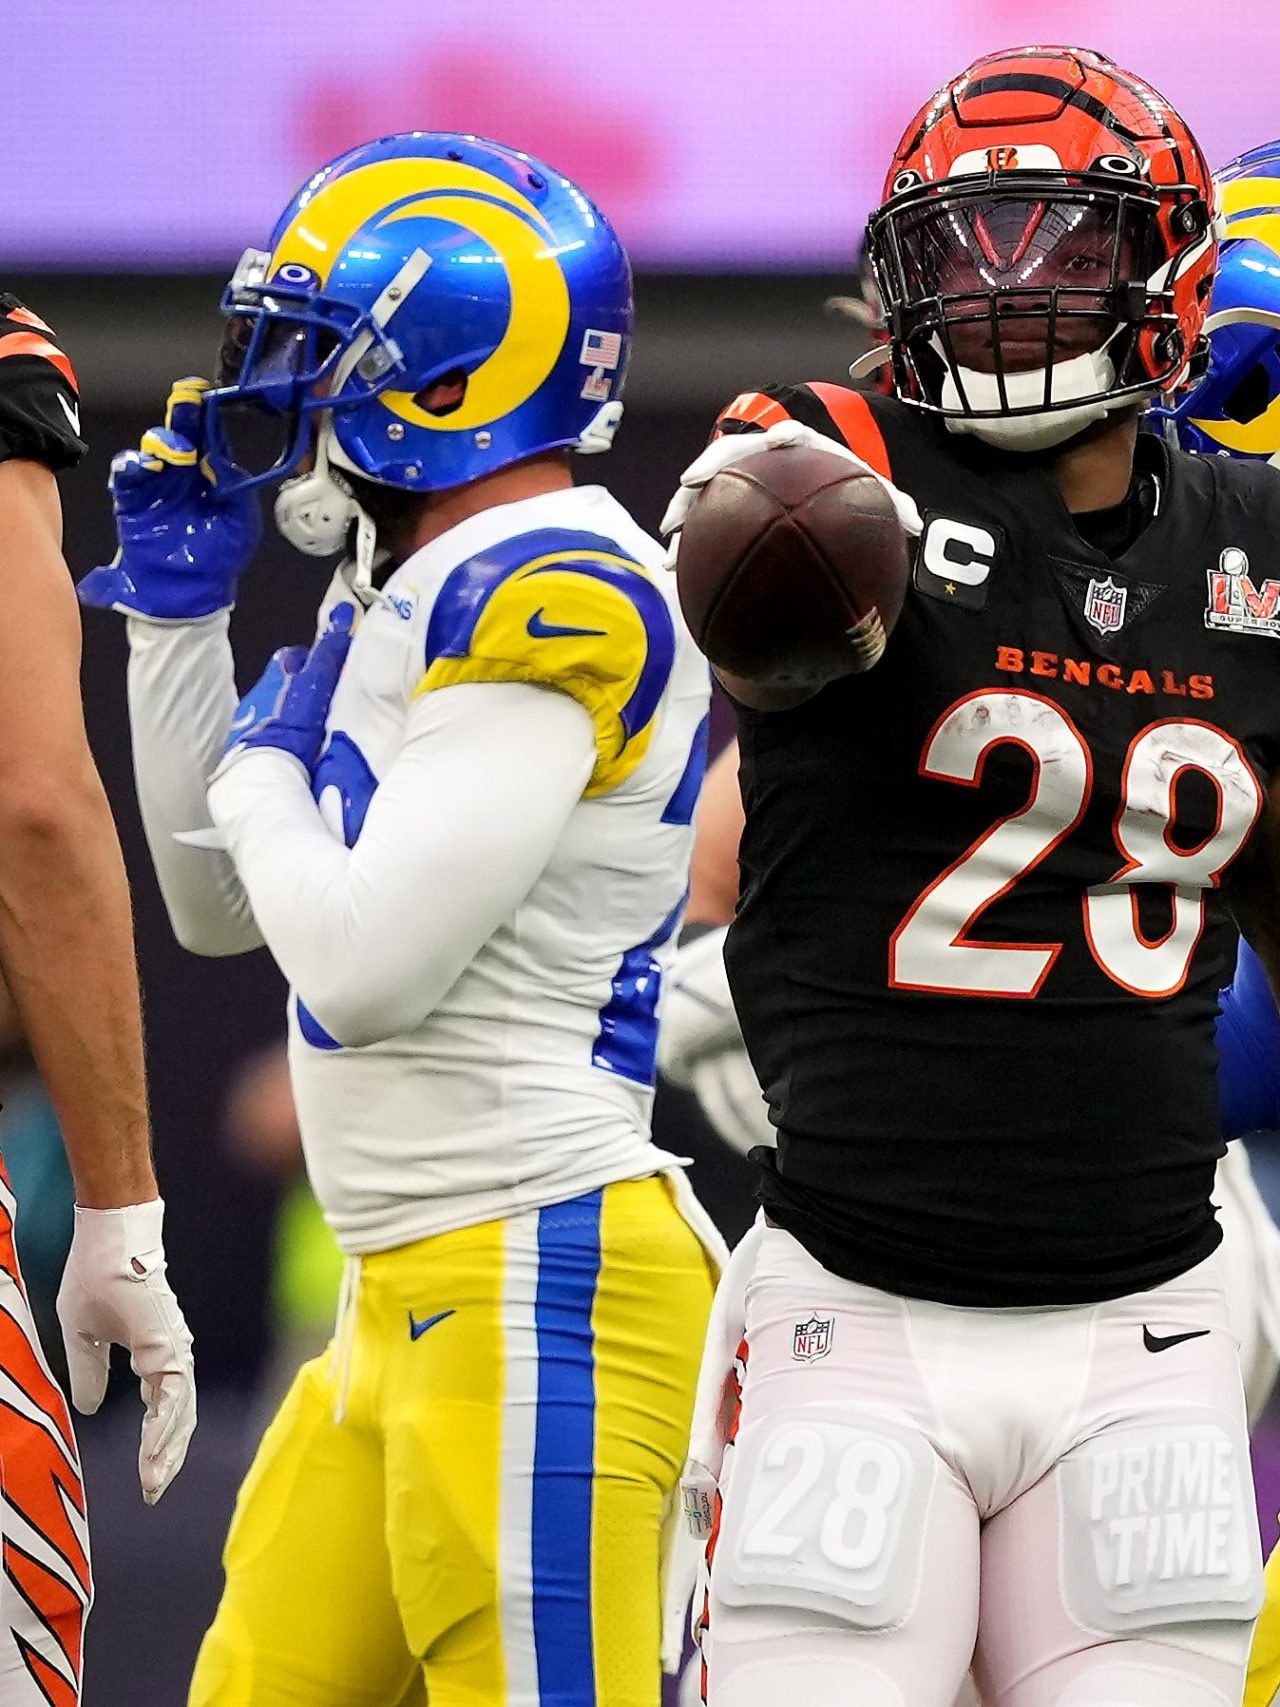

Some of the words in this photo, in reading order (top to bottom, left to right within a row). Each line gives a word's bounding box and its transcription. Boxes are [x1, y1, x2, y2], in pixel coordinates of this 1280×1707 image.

[924, 518, 995, 586] C
[1092, 601, 1121, 625] NFL
[994, 645, 1214, 699] BENGALS
[888, 687, 1263, 998] 28
[797, 1335, 824, 1354] NFL
[743, 1427, 901, 1570] 28
[1091, 1440, 1232, 1522] PRIME
[1109, 1509, 1231, 1585] TIME
